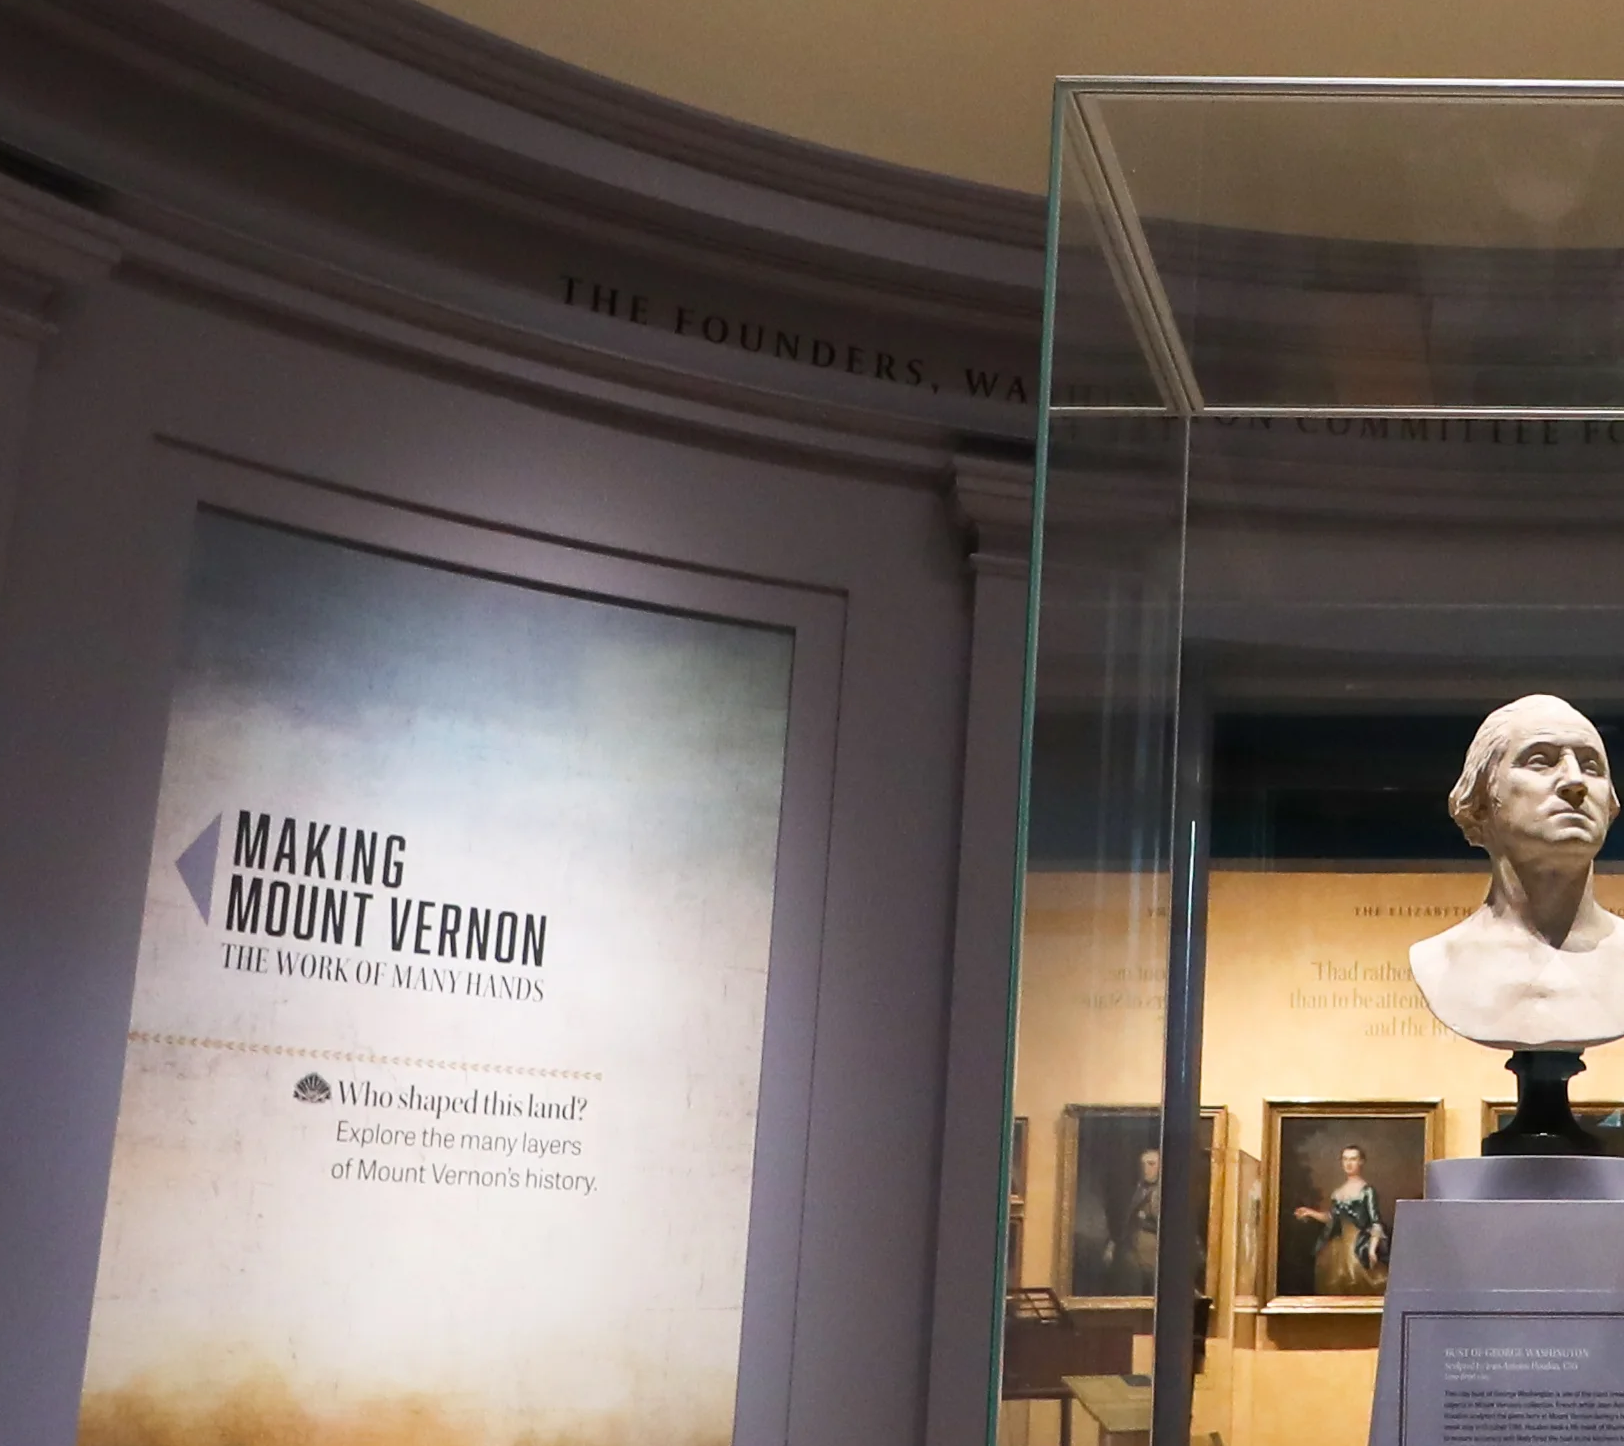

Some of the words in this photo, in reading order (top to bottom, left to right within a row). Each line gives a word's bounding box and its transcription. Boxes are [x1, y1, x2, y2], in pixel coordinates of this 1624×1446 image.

[560, 275, 649, 326] THE
[674, 306, 940, 395] FOUNDERS,
[234, 809, 406, 888] MAKING
[226, 873, 374, 948] MOUNT
[390, 896, 548, 967] VERNON
[221, 942, 269, 974] THE
[276, 950, 351, 983] WORK
[355, 958, 386, 987] OF
[391, 963, 461, 995] MANY
[465, 971, 544, 1003] HANDS
[1327, 960, 1359, 982] had
[1290, 988, 1328, 1009] than
[1332, 991, 1349, 1009] to
[1353, 988, 1375, 1009] be
[1364, 1016, 1397, 1037] and
[337, 1079, 394, 1108] Who
[398, 1085, 478, 1119] shaped
[483, 1089, 524, 1117] this
[527, 1093, 588, 1121] land?
[336, 1119, 416, 1149] Explore
[422, 1127, 455, 1149] the
[460, 1133, 518, 1157] many
[522, 1131, 582, 1158] layers
[331, 1158, 354, 1180] of
[357, 1158, 427, 1184] Mount
[432, 1163, 520, 1189] Vernon's
[525, 1168, 599, 1196] history.
